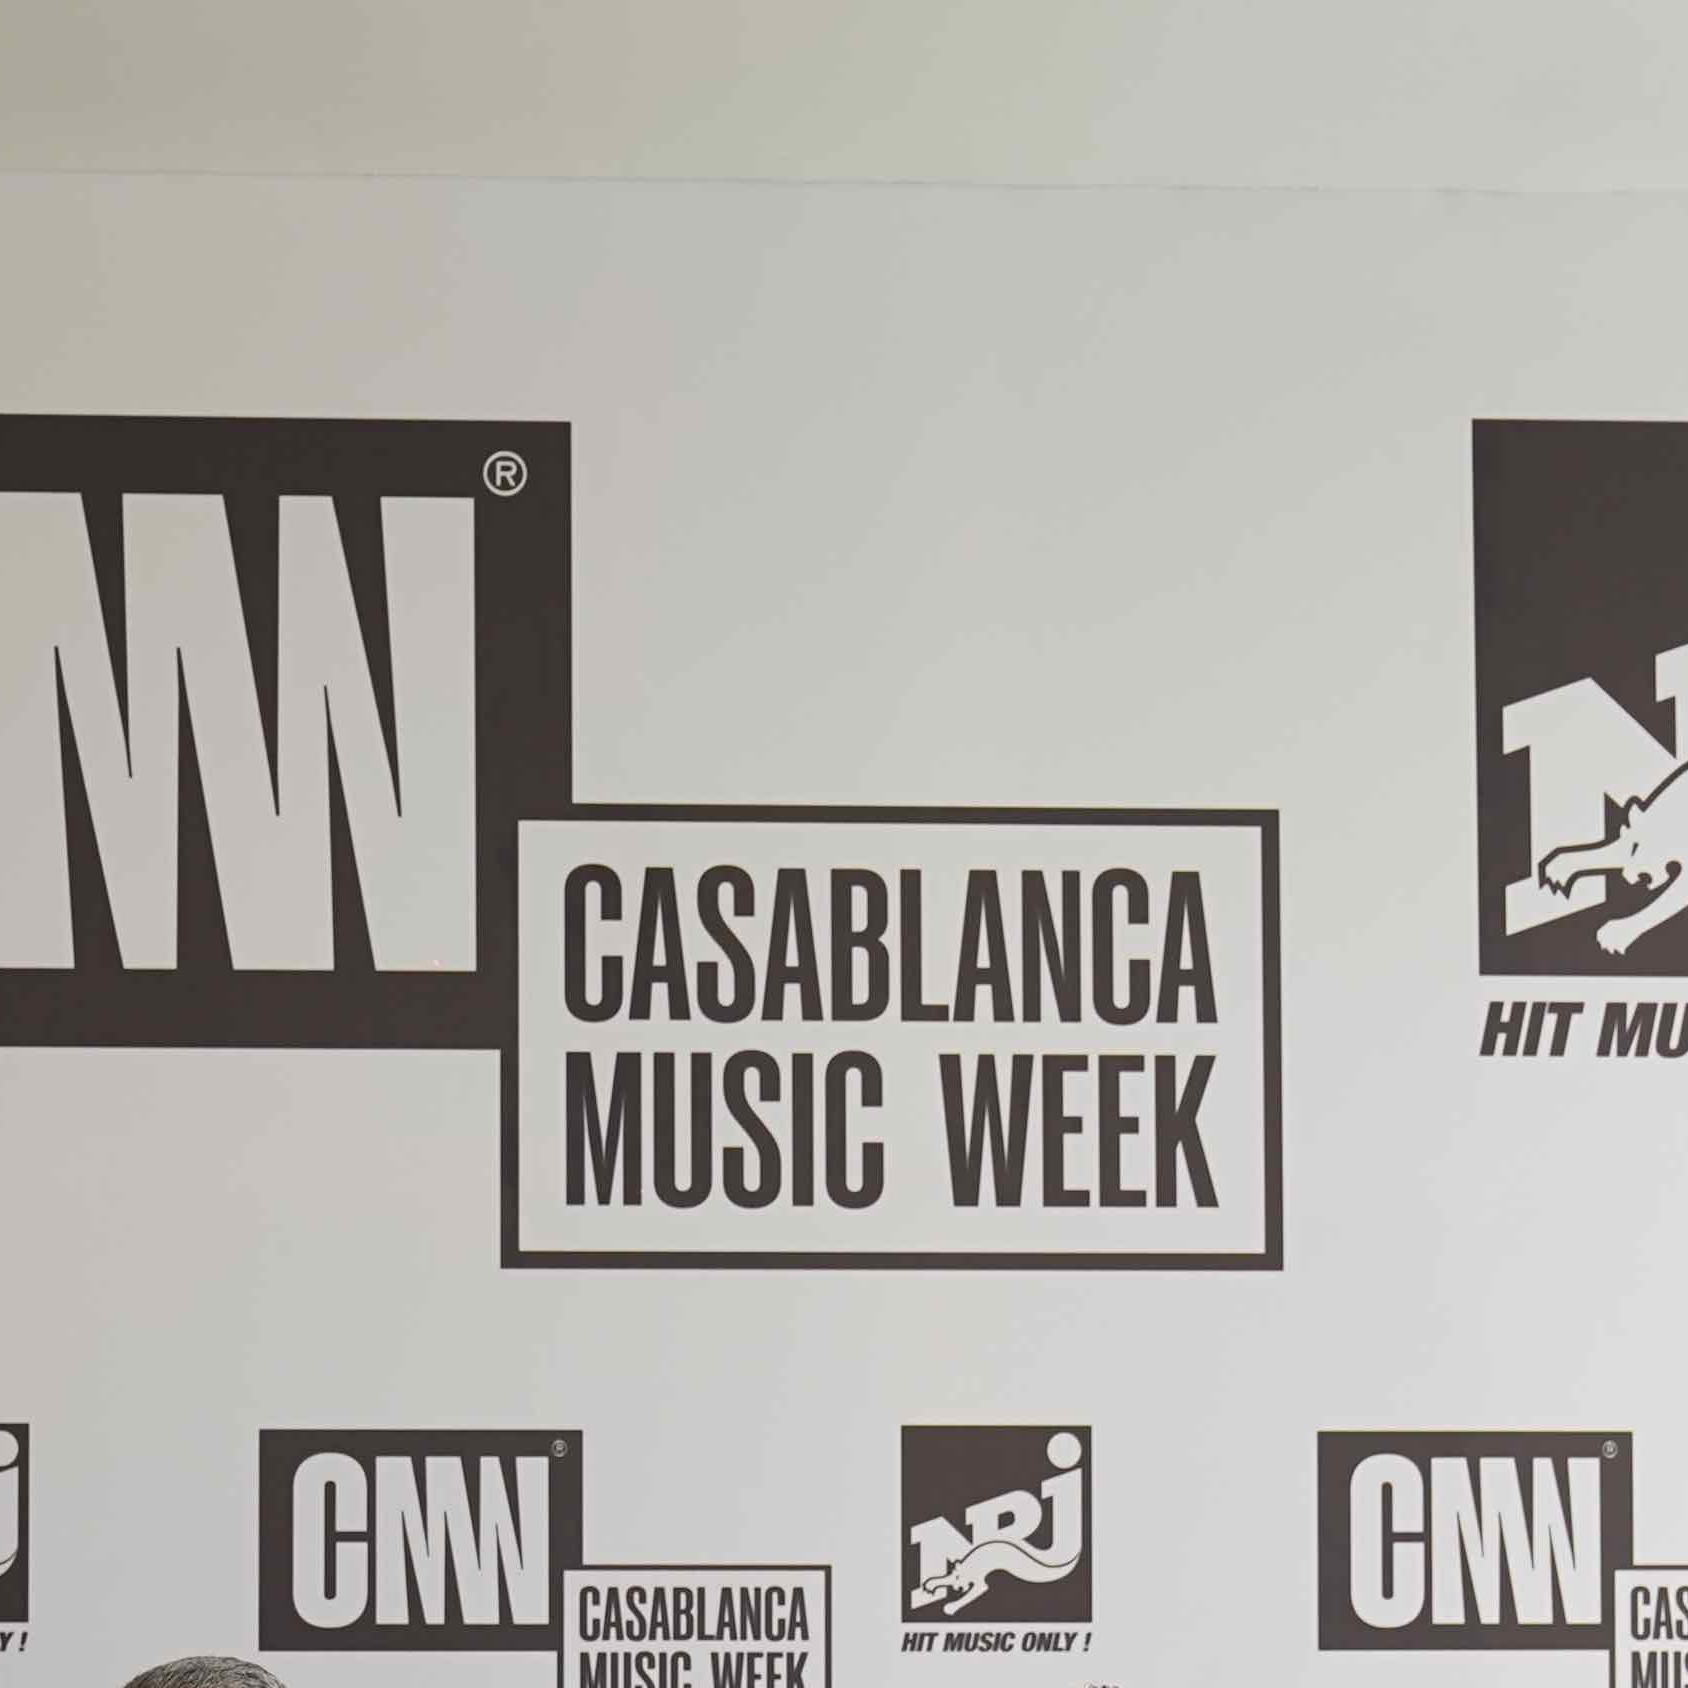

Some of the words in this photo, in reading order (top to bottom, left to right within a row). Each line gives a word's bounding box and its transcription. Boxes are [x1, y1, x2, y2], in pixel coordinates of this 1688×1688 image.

[565, 864, 1217, 1025] CASABLANCA
[1480, 1001, 1584, 1057] HIT
[566, 1050, 884, 1209] MUSIC
[939, 1054, 1219, 1208] WEEK
[579, 1585, 809, 1641] CASABLANCA
[901, 1632, 939, 1652] HIT
[943, 1632, 1015, 1652] MUSIC
[1021, 1632, 1078, 1652] ONLY
